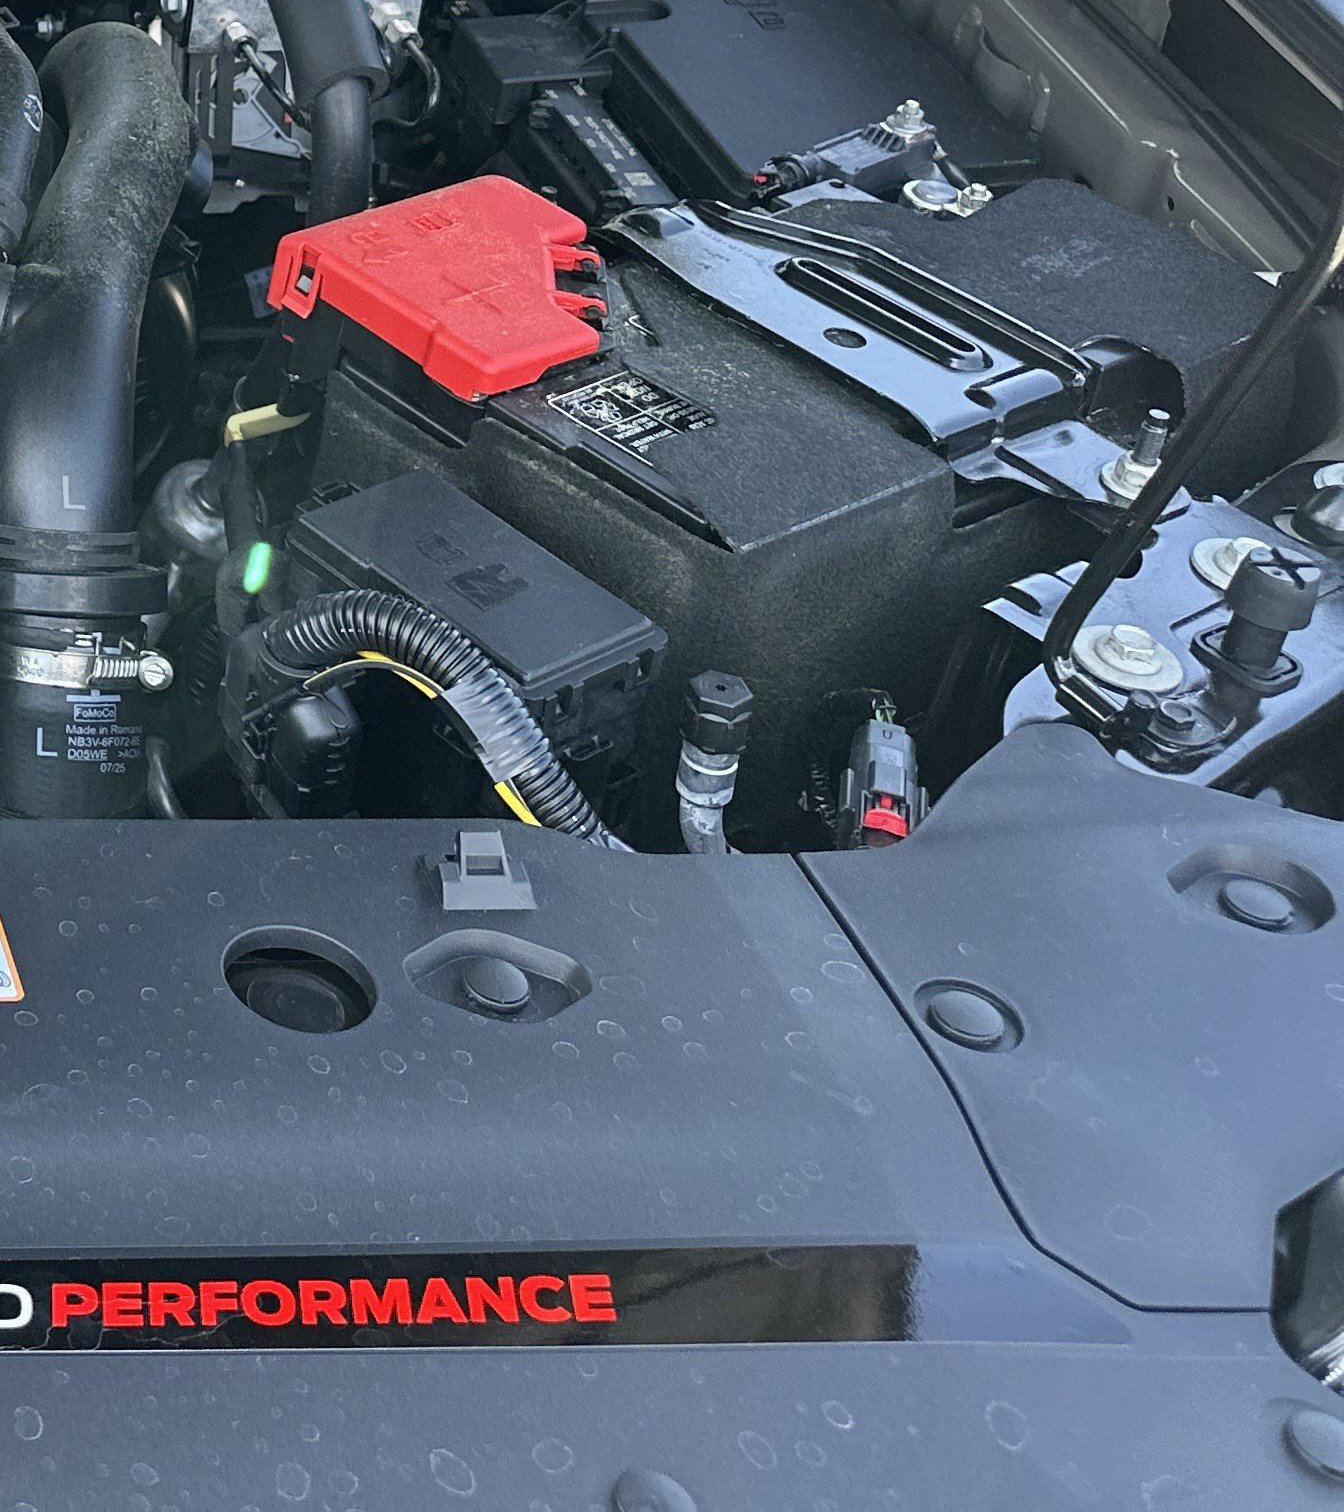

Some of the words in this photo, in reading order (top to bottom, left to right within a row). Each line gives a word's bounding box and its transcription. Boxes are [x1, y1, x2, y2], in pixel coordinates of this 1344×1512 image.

[62, 475, 86, 510] L
[36, 727, 58, 757] L
[65, 724, 97, 734] Made
[99, 725, 108, 734] in
[51, 1274, 618, 1328] PERFORMANCE
